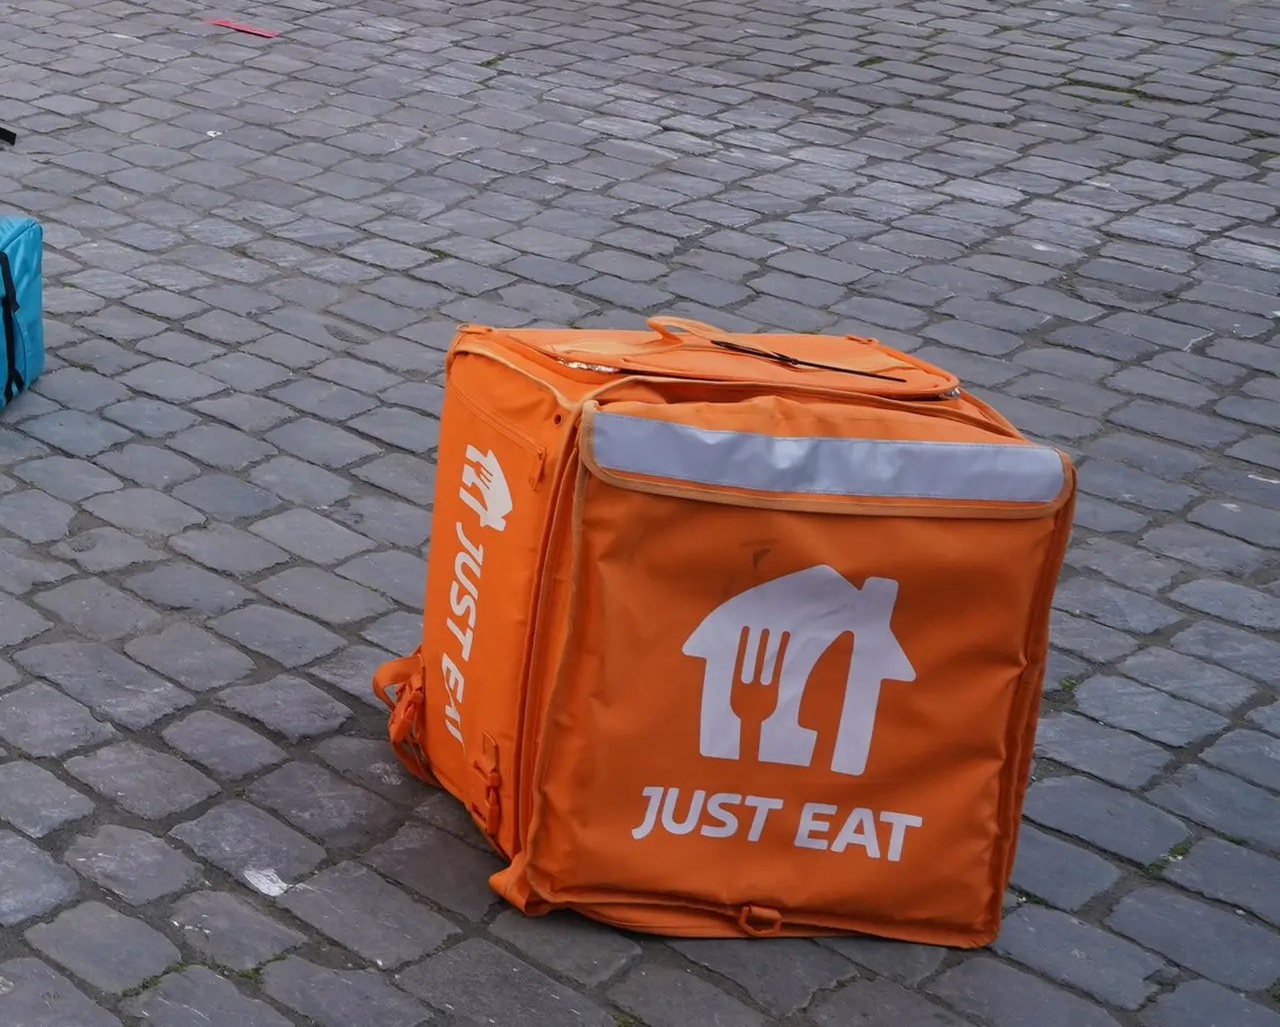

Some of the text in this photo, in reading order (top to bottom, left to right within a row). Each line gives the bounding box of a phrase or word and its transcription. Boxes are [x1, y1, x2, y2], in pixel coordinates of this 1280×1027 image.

[446, 521, 485, 661] JUST
[631, 786, 924, 862] JUST EAT
